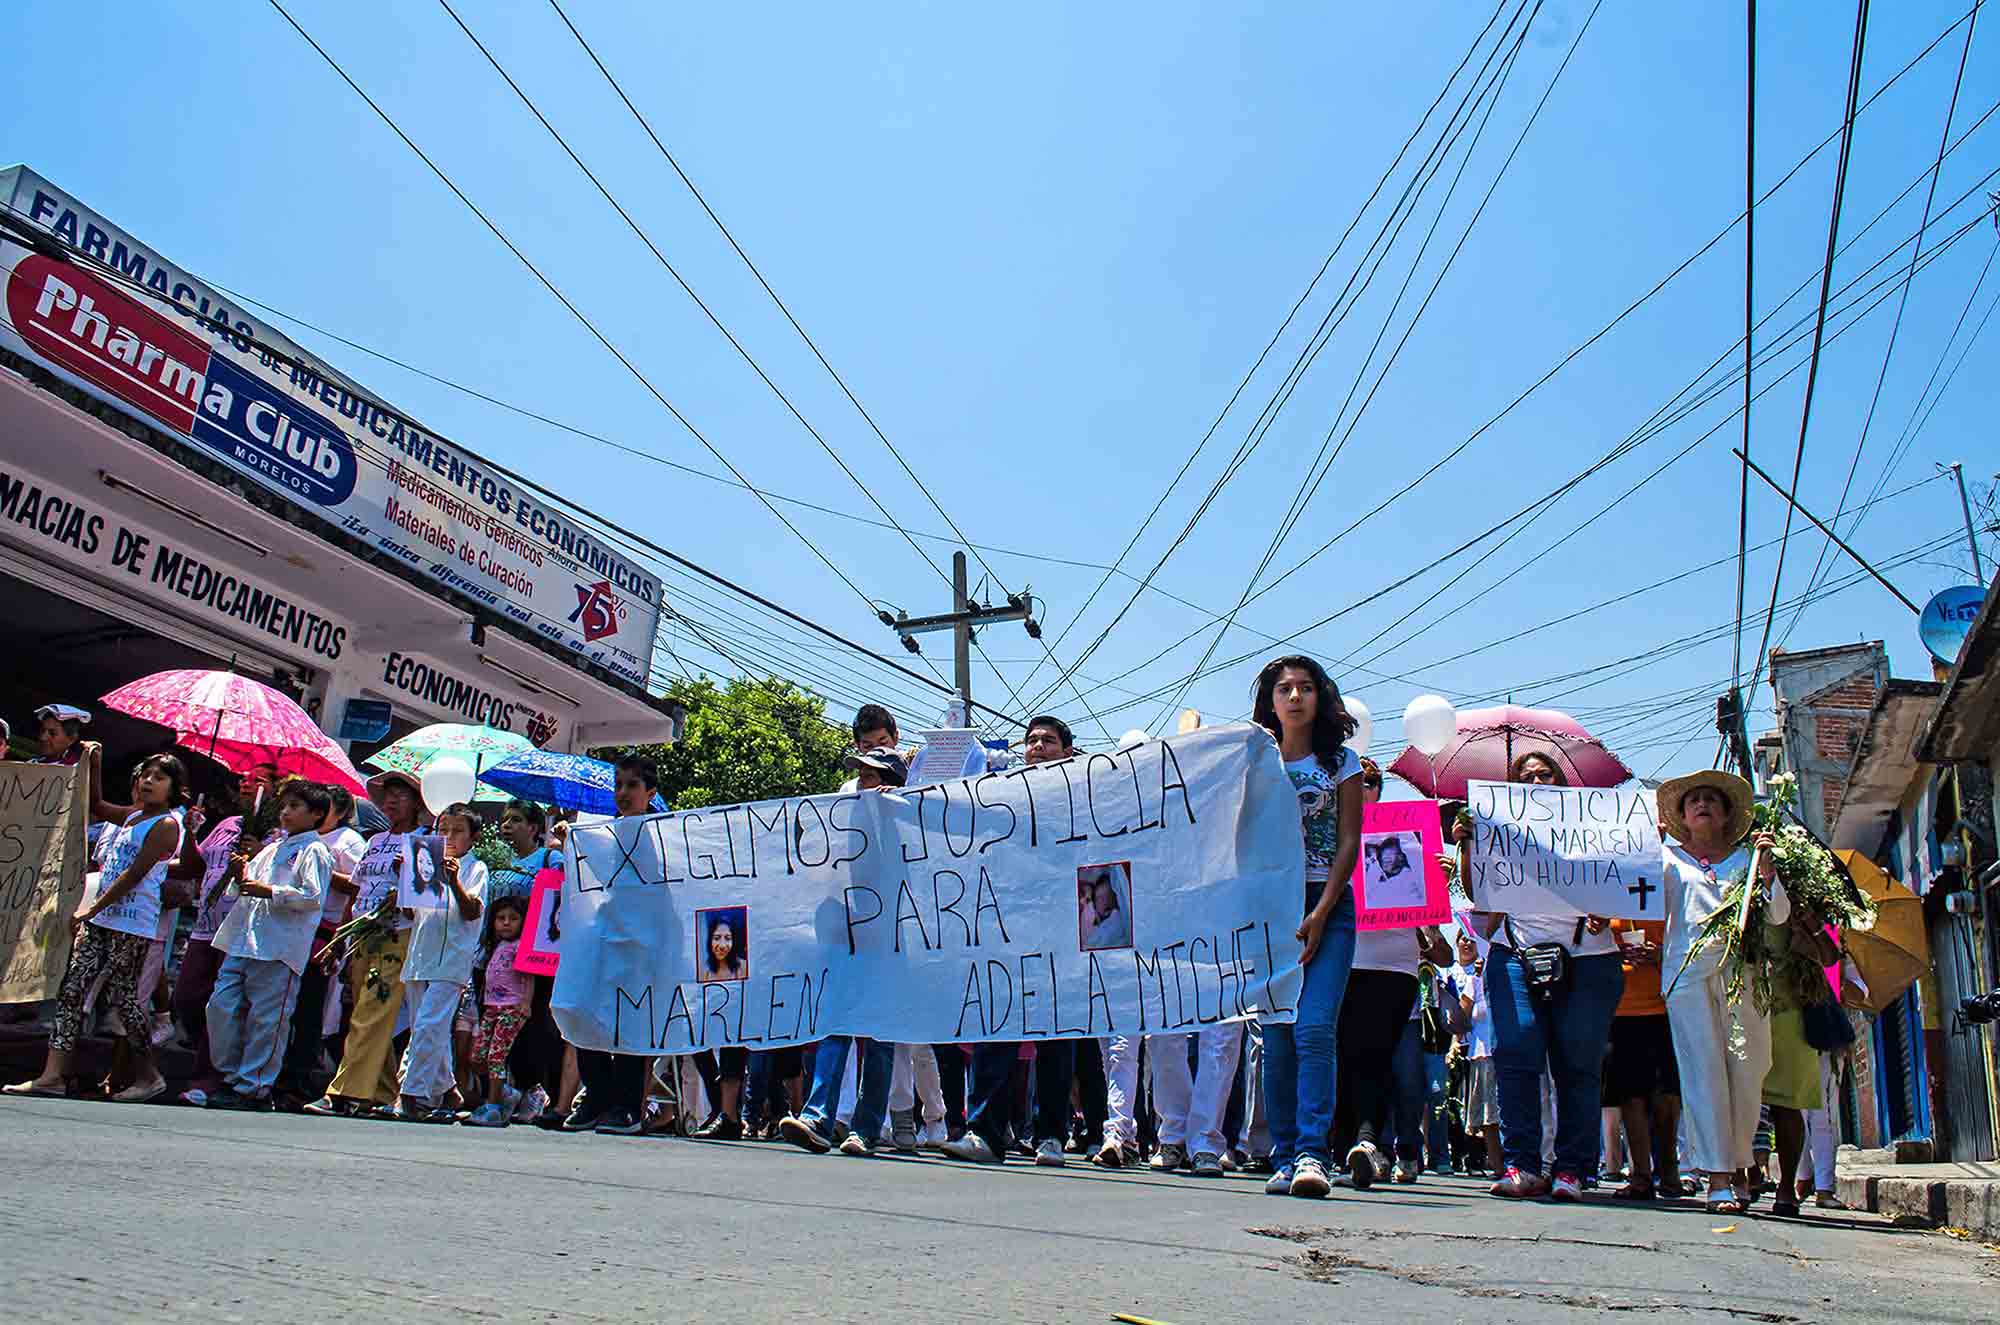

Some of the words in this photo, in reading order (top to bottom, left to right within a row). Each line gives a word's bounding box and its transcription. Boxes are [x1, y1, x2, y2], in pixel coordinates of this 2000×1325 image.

[29, 189, 254, 353] FARMACIAS
[259, 351, 281, 375] DE
[289, 366, 510, 514] MEDICAMENTOS
[34, 273, 233, 419] Pharma
[245, 399, 341, 479] Club
[234, 444, 311, 495] MORELOS
[386, 457, 481, 531] Medicamentos
[112, 526, 150, 576] DE
[151, 545, 347, 661] MEDICAMENTOS
[385, 494, 456, 555] Materiales
[459, 540, 476, 566] de
[478, 550, 534, 599] Curación
[429, 562, 499, 606] diferencia
[503, 604, 534, 623] real
[569, 639, 586, 652] en
[591, 651, 606, 662] el
[383, 651, 514, 732] ECONOMICOS
[569, 794, 868, 893] EXIGIMOS
[900, 740, 1197, 863] JUSTICIA
[1473, 823, 1540, 857] PARA
[1550, 828, 1643, 856] MARLEN
[1475, 784, 1654, 826] JUSTICIA
[844, 866, 1011, 955] PARA
[1472, 861, 1488, 889] Y
[1495, 861, 1525, 887] SU
[1537, 859, 1623, 887] HIJITA
[612, 968, 829, 1049] MARLEN
[954, 951, 1115, 1038] ADELA
[1134, 920, 1294, 1031] MICHEL
